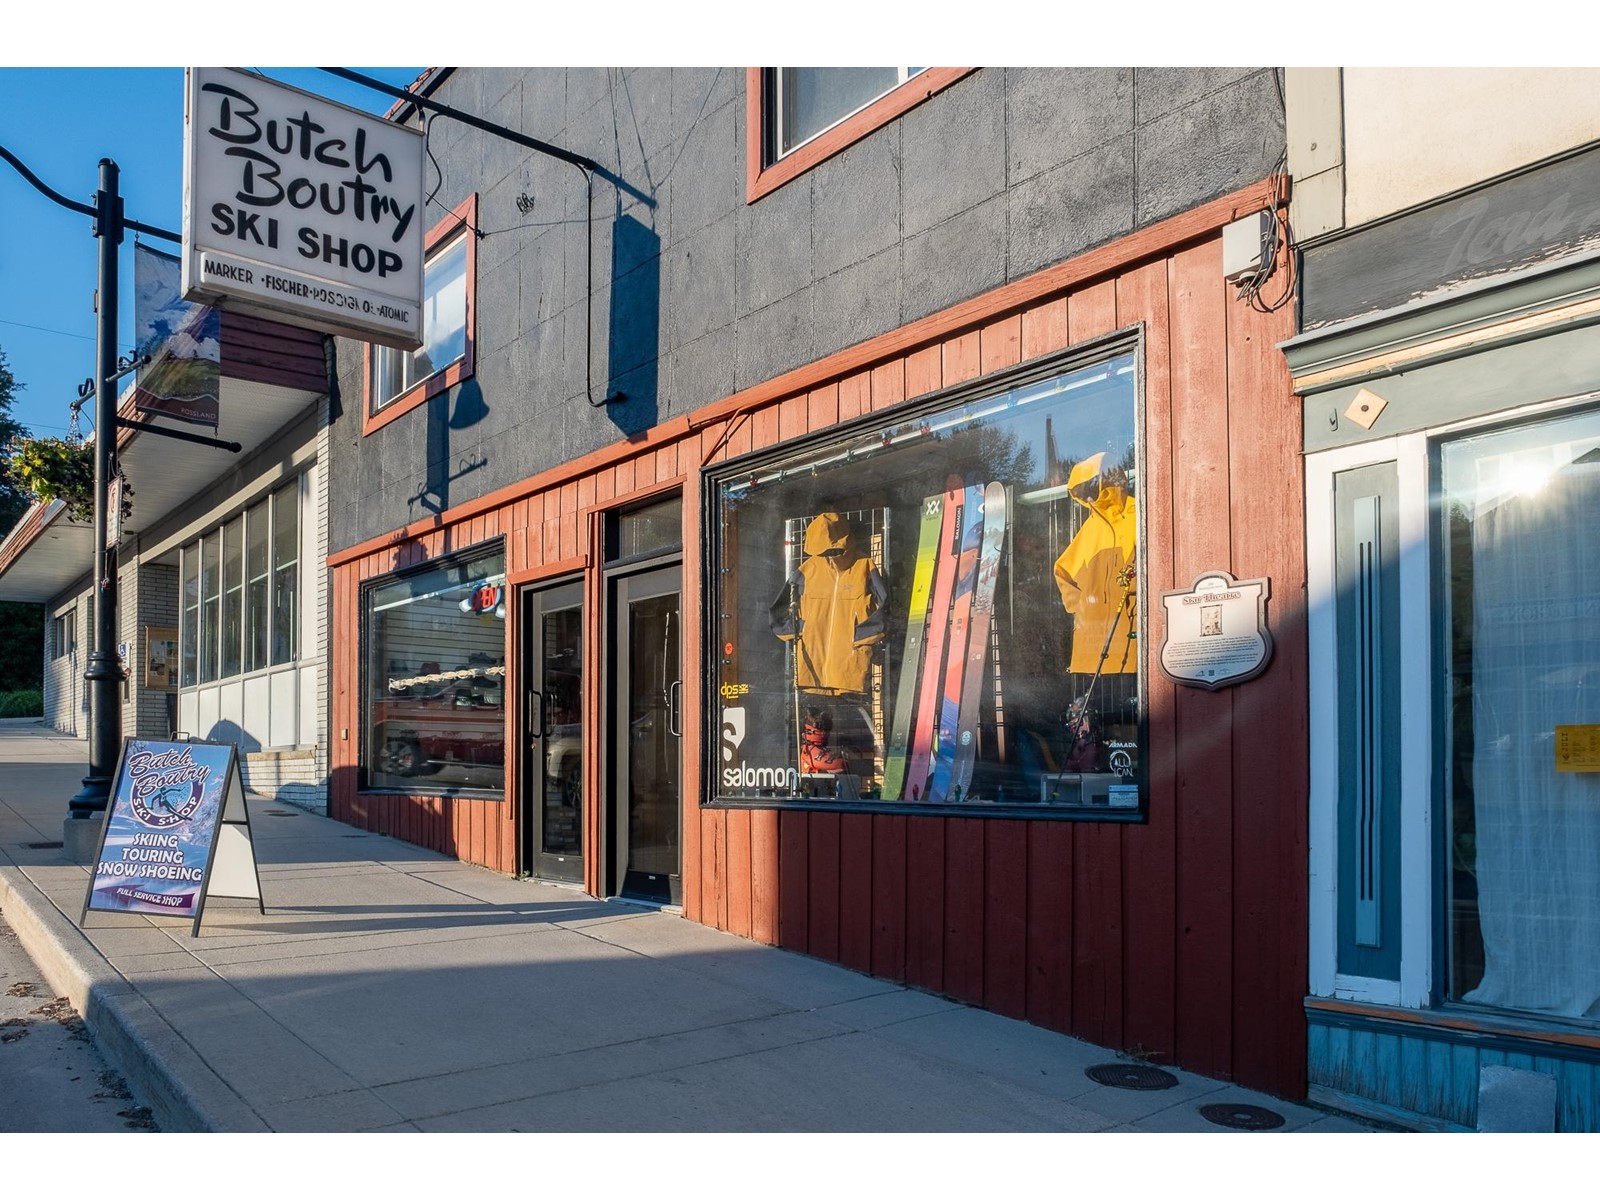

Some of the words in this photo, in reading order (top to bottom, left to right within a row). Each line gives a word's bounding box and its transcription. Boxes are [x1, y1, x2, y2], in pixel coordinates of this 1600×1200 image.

[202, 83, 392, 182] Butch
[224, 146, 415, 243] Boutry
[211, 203, 278, 249] SKI
[298, 227, 403, 278] SHOP
[204, 260, 253, 284] MARKER
[266, 275, 308, 298] FISCHER
[379, 305, 409, 323] ATOMIC
[181, 407, 216, 419] ROSSLAND
[471, 586, 498, 611] OPEN
[720, 681, 739, 699] dps
[129, 747, 192, 777] Butch
[723, 760, 797, 787] salomon
[136, 764, 211, 797] Boutry
[133, 833, 179, 848] SKIING
[122, 848, 184, 864] TOURING
[96, 861, 138, 877] SNOW
[139, 864, 203, 881] SHOEING
[116, 888, 133, 897] FULL
[134, 890, 161, 904] SERVICE
[162, 896, 183, 907] SHOP
